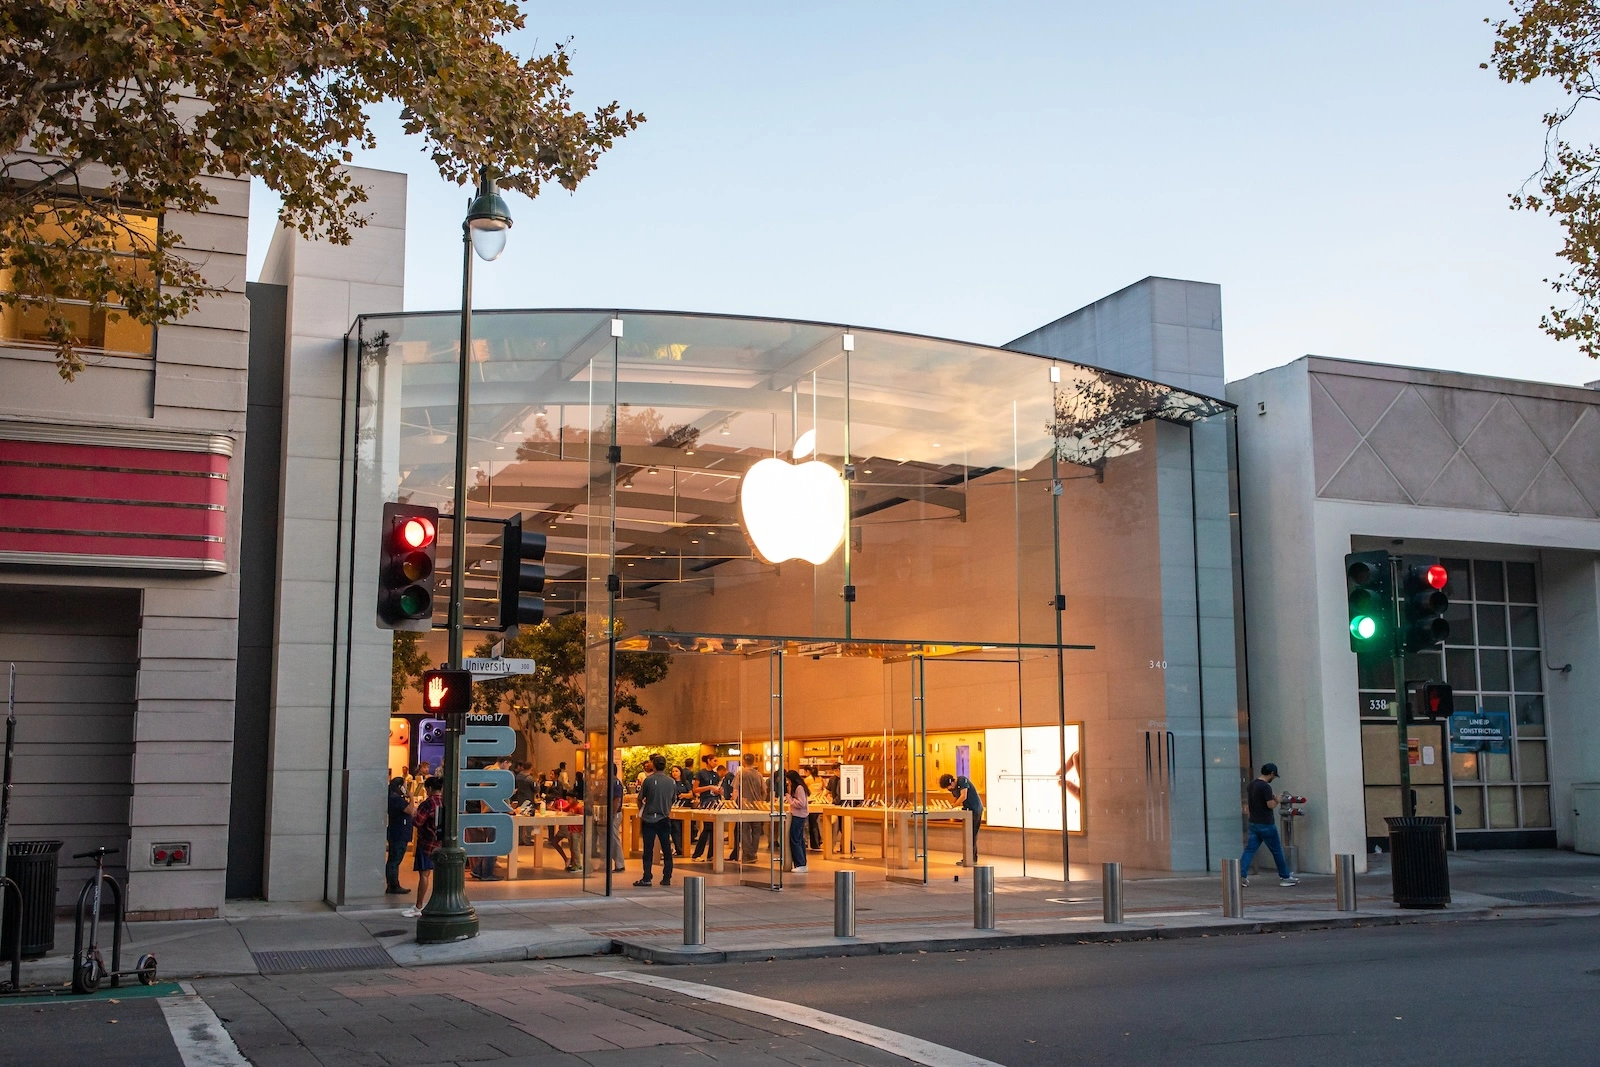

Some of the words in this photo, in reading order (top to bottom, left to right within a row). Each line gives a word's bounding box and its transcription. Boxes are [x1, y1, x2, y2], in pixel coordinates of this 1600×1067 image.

[465, 659, 511, 672] University
[1149, 660, 1168, 669] 340
[1369, 699, 1387, 710] 338
[465, 712, 494, 722] Phone
[494, 712, 504, 722] 17
